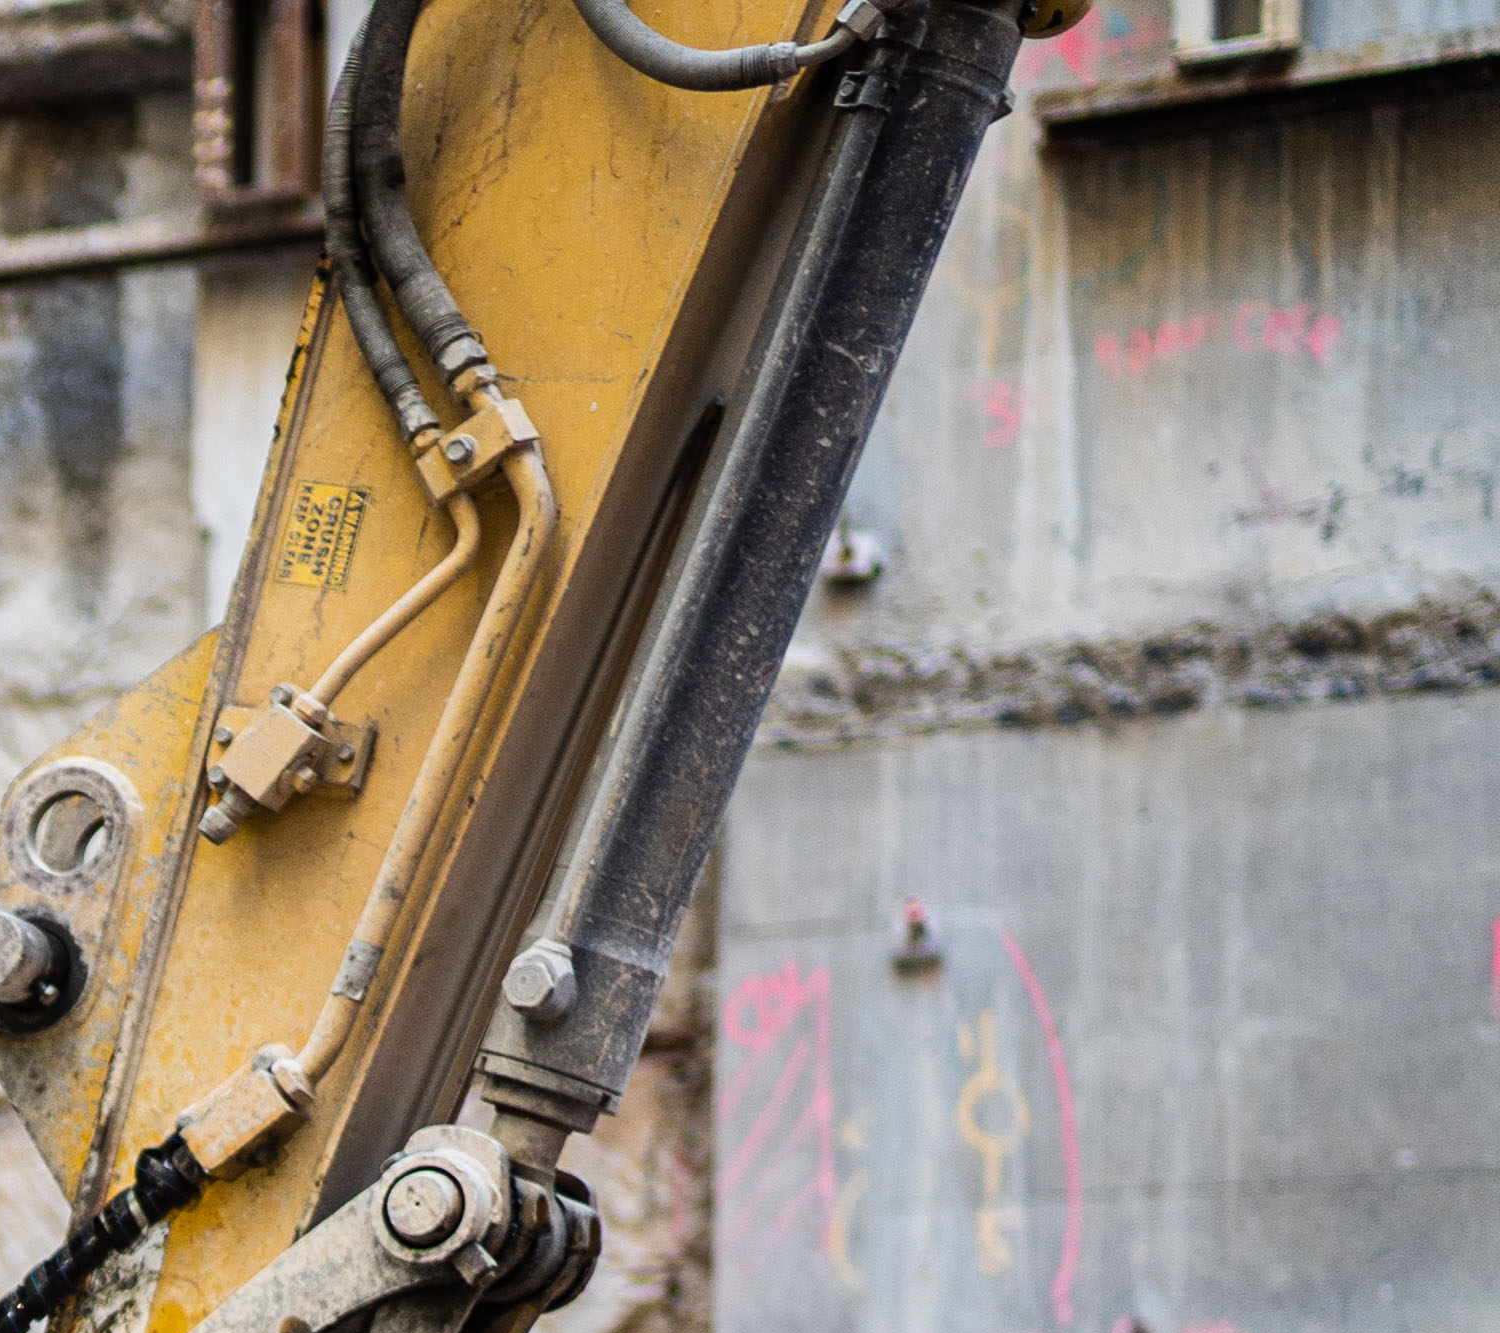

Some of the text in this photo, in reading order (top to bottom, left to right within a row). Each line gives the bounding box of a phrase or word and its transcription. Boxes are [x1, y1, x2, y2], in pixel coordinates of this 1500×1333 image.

[279, 485, 314, 579] KEEP CLEAR
[299, 504, 323, 564] ZONE
[312, 496, 342, 576] CRUSH
